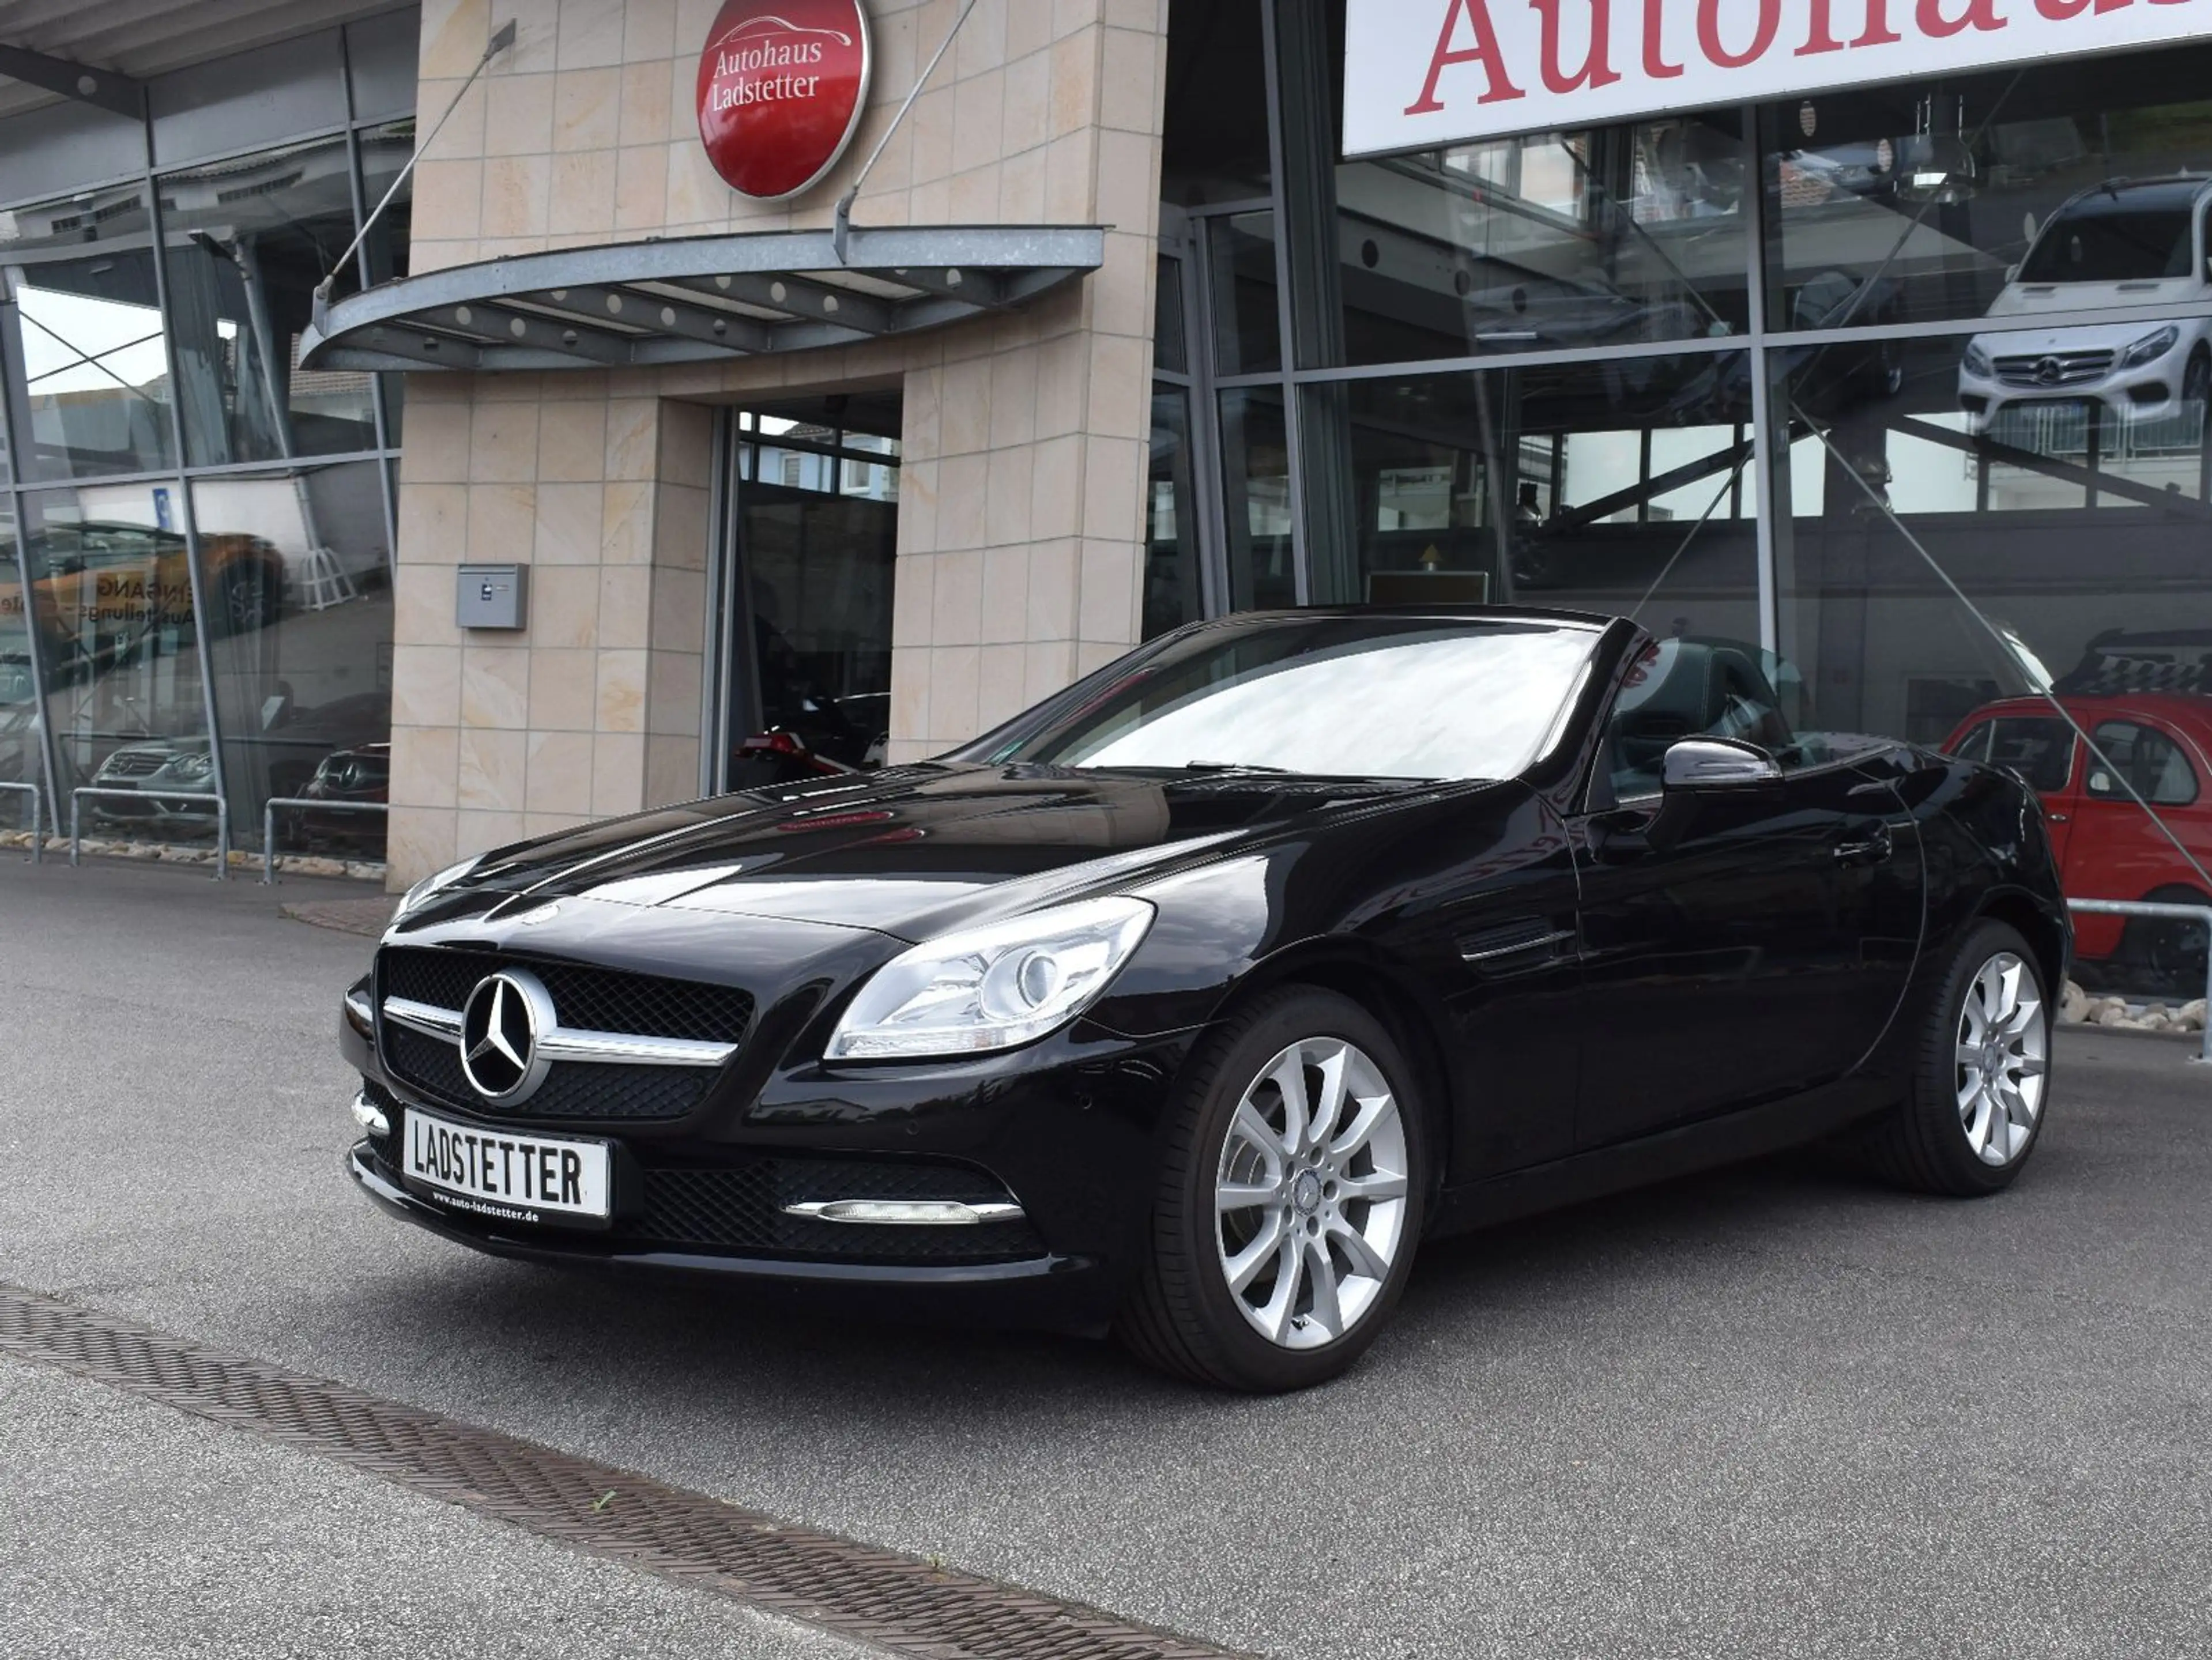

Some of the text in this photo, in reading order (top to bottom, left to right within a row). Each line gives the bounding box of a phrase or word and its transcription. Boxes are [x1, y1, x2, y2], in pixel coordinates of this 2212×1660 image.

[713, 40, 822, 78] Autohaus
[713, 73, 820, 112] Ladstetter
[414, 1120, 582, 1205] LADSTETTER
[434, 1193, 539, 1223] www.auto-ladstetter.de
